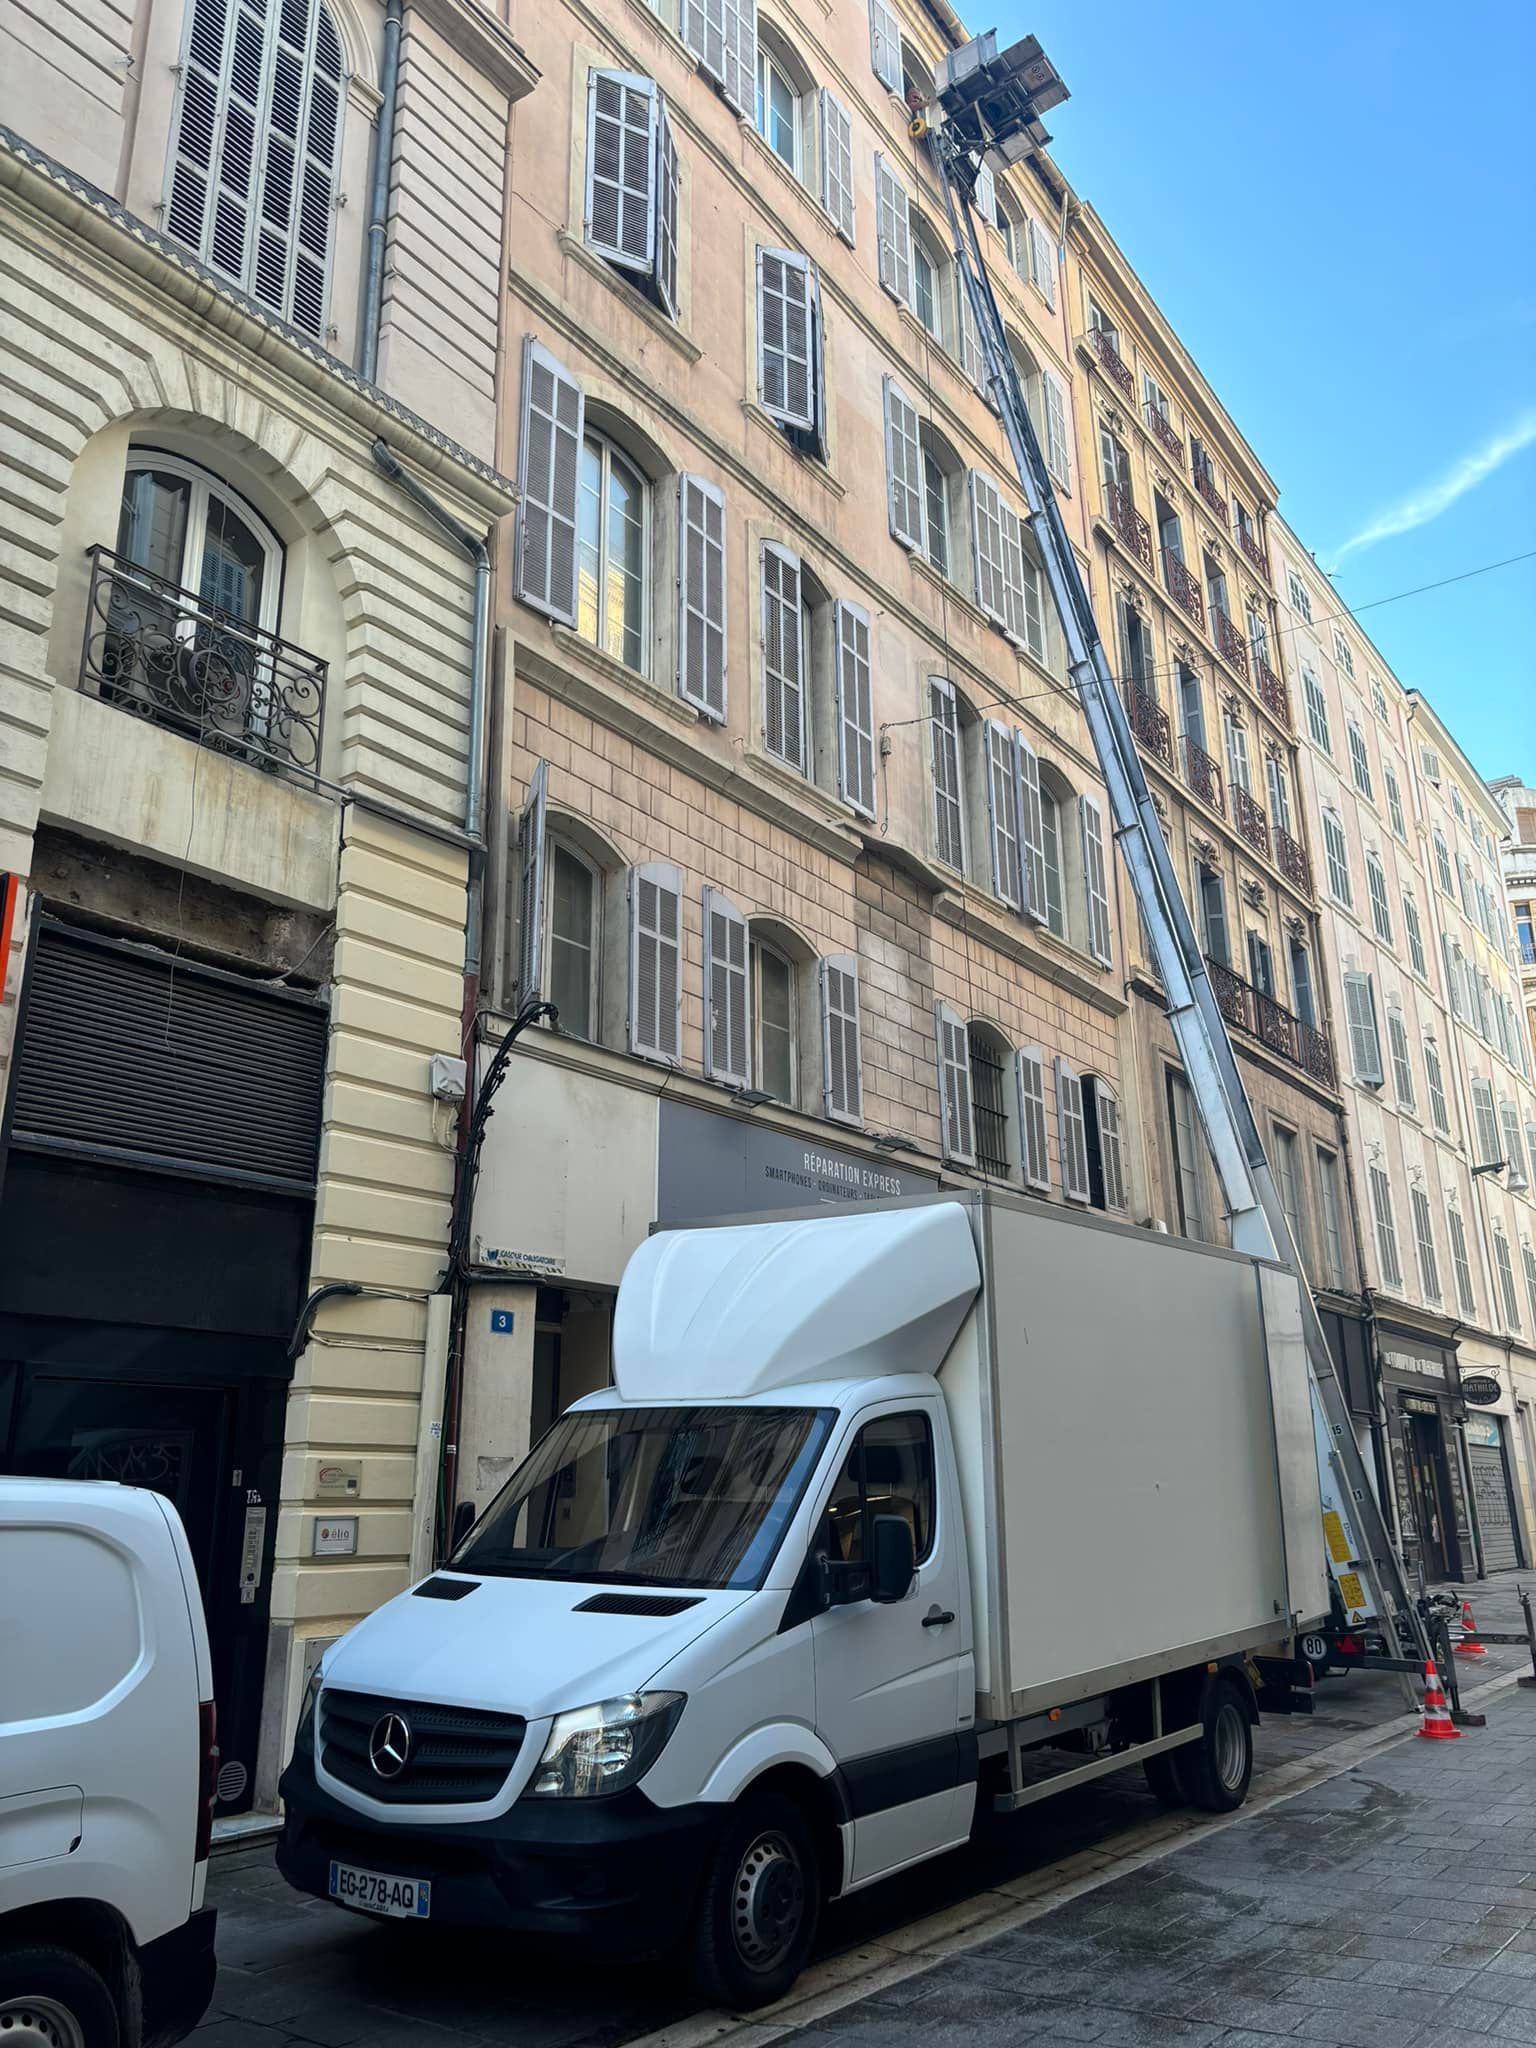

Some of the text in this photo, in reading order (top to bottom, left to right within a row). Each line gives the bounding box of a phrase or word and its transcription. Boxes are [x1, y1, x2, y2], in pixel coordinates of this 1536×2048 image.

[764, 1165, 812, 1189] SMARTPHONES
[804, 1152, 901, 1195] RÉPARATION EXPRESS
[498, 1315, 507, 1328] 3
[1332, 1425, 1342, 1436] 15
[1306, 1638, 1322, 1655] 80
[340, 1869, 414, 1909] EG-278-AQ
